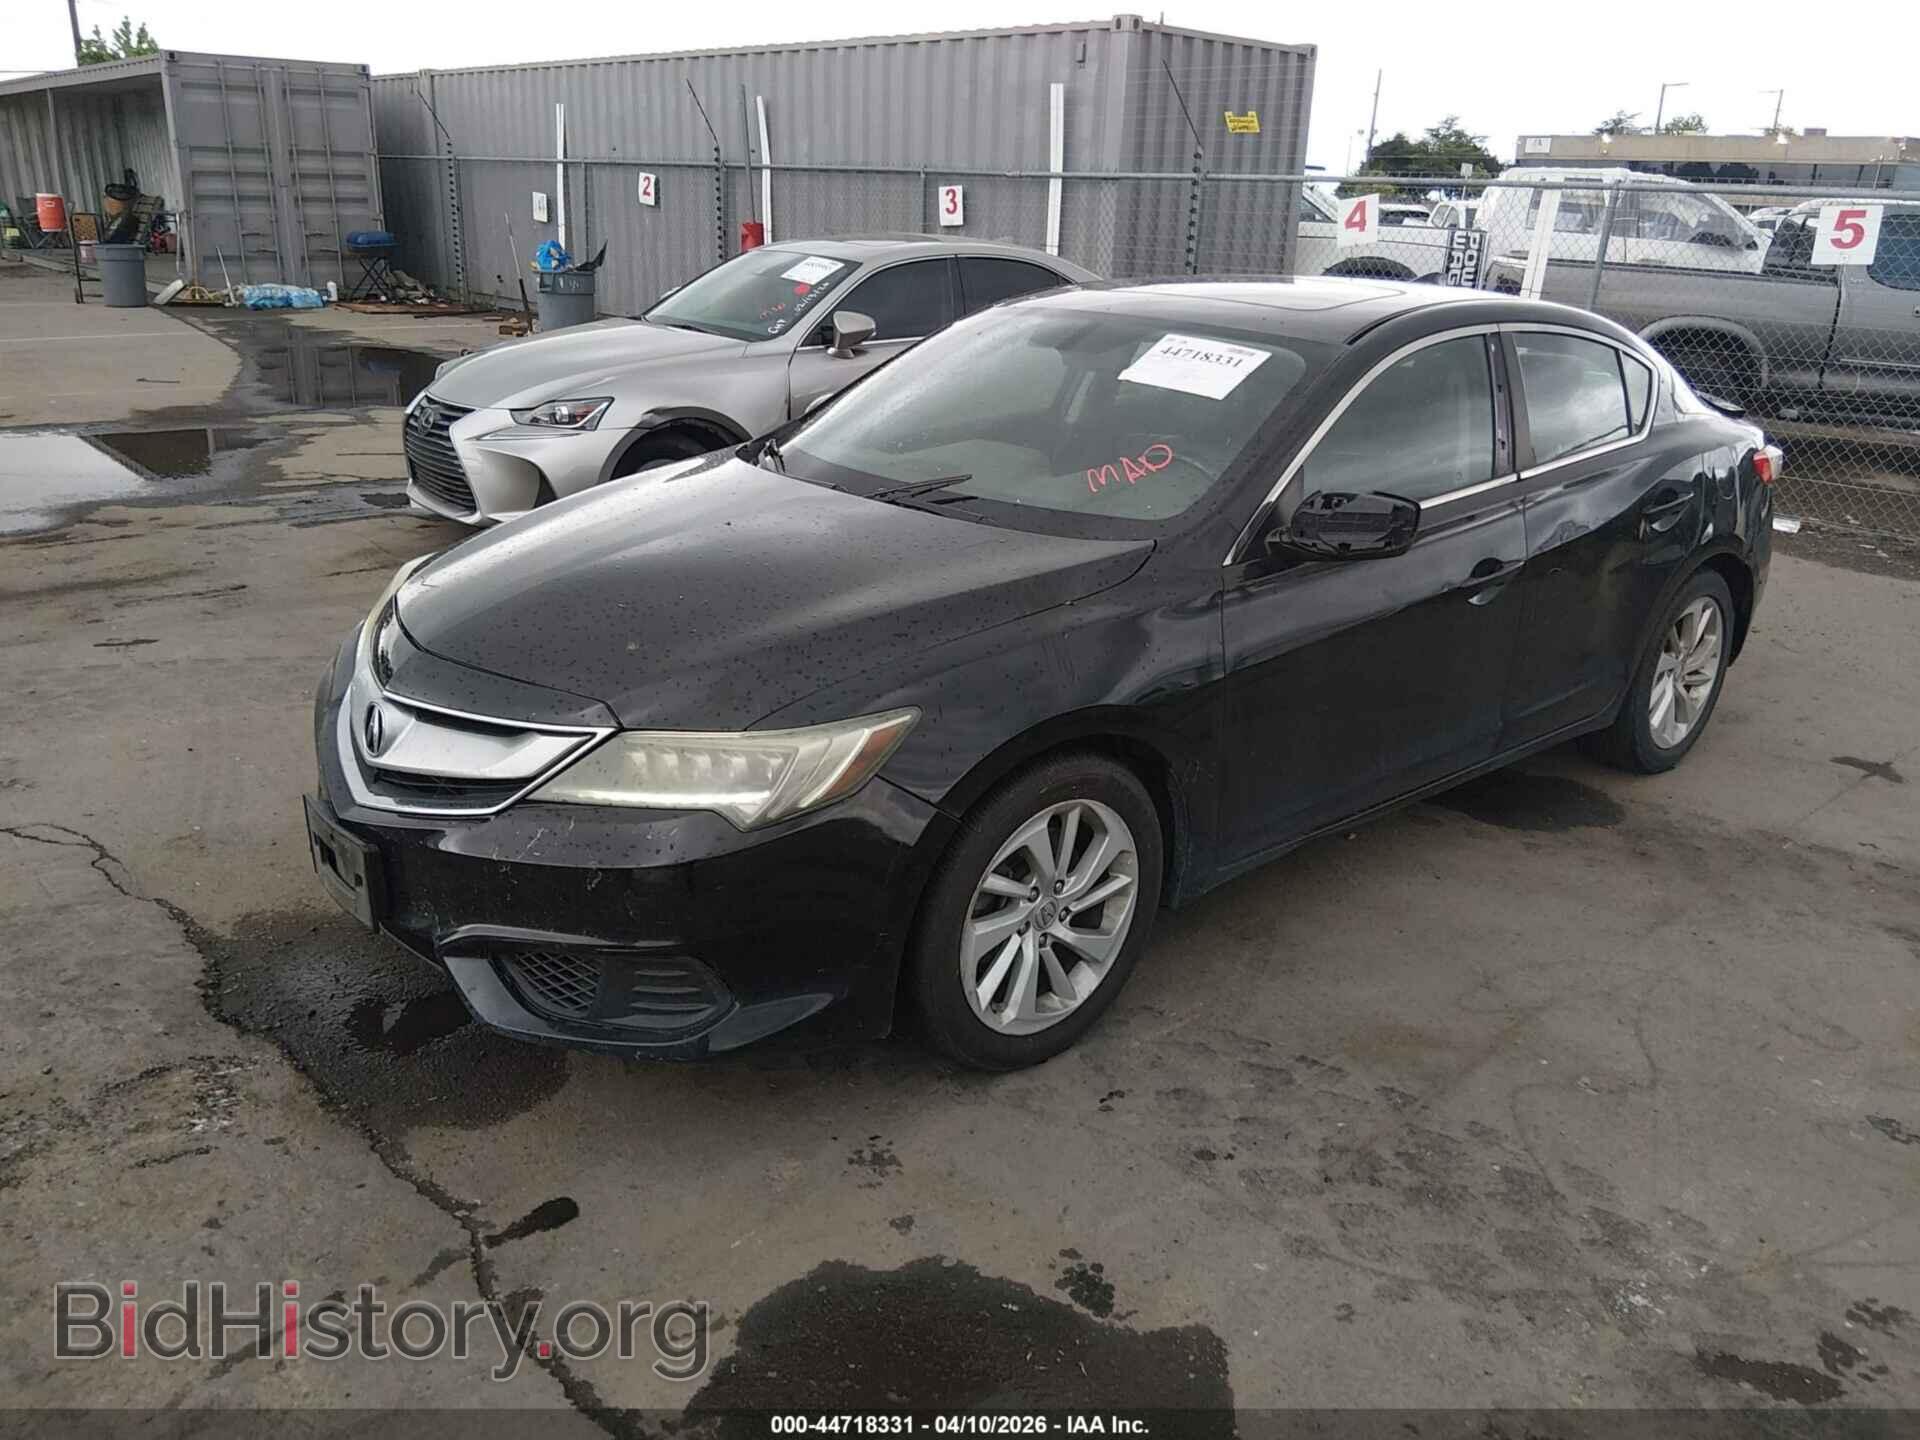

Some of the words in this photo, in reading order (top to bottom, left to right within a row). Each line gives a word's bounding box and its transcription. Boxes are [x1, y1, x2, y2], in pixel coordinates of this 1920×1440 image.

[642, 175, 652, 197] 2
[945, 187, 958, 215] 3
[1344, 200, 1367, 232] 4
[1829, 209, 1868, 250] 5
[1160, 345, 1244, 368] 44718331
